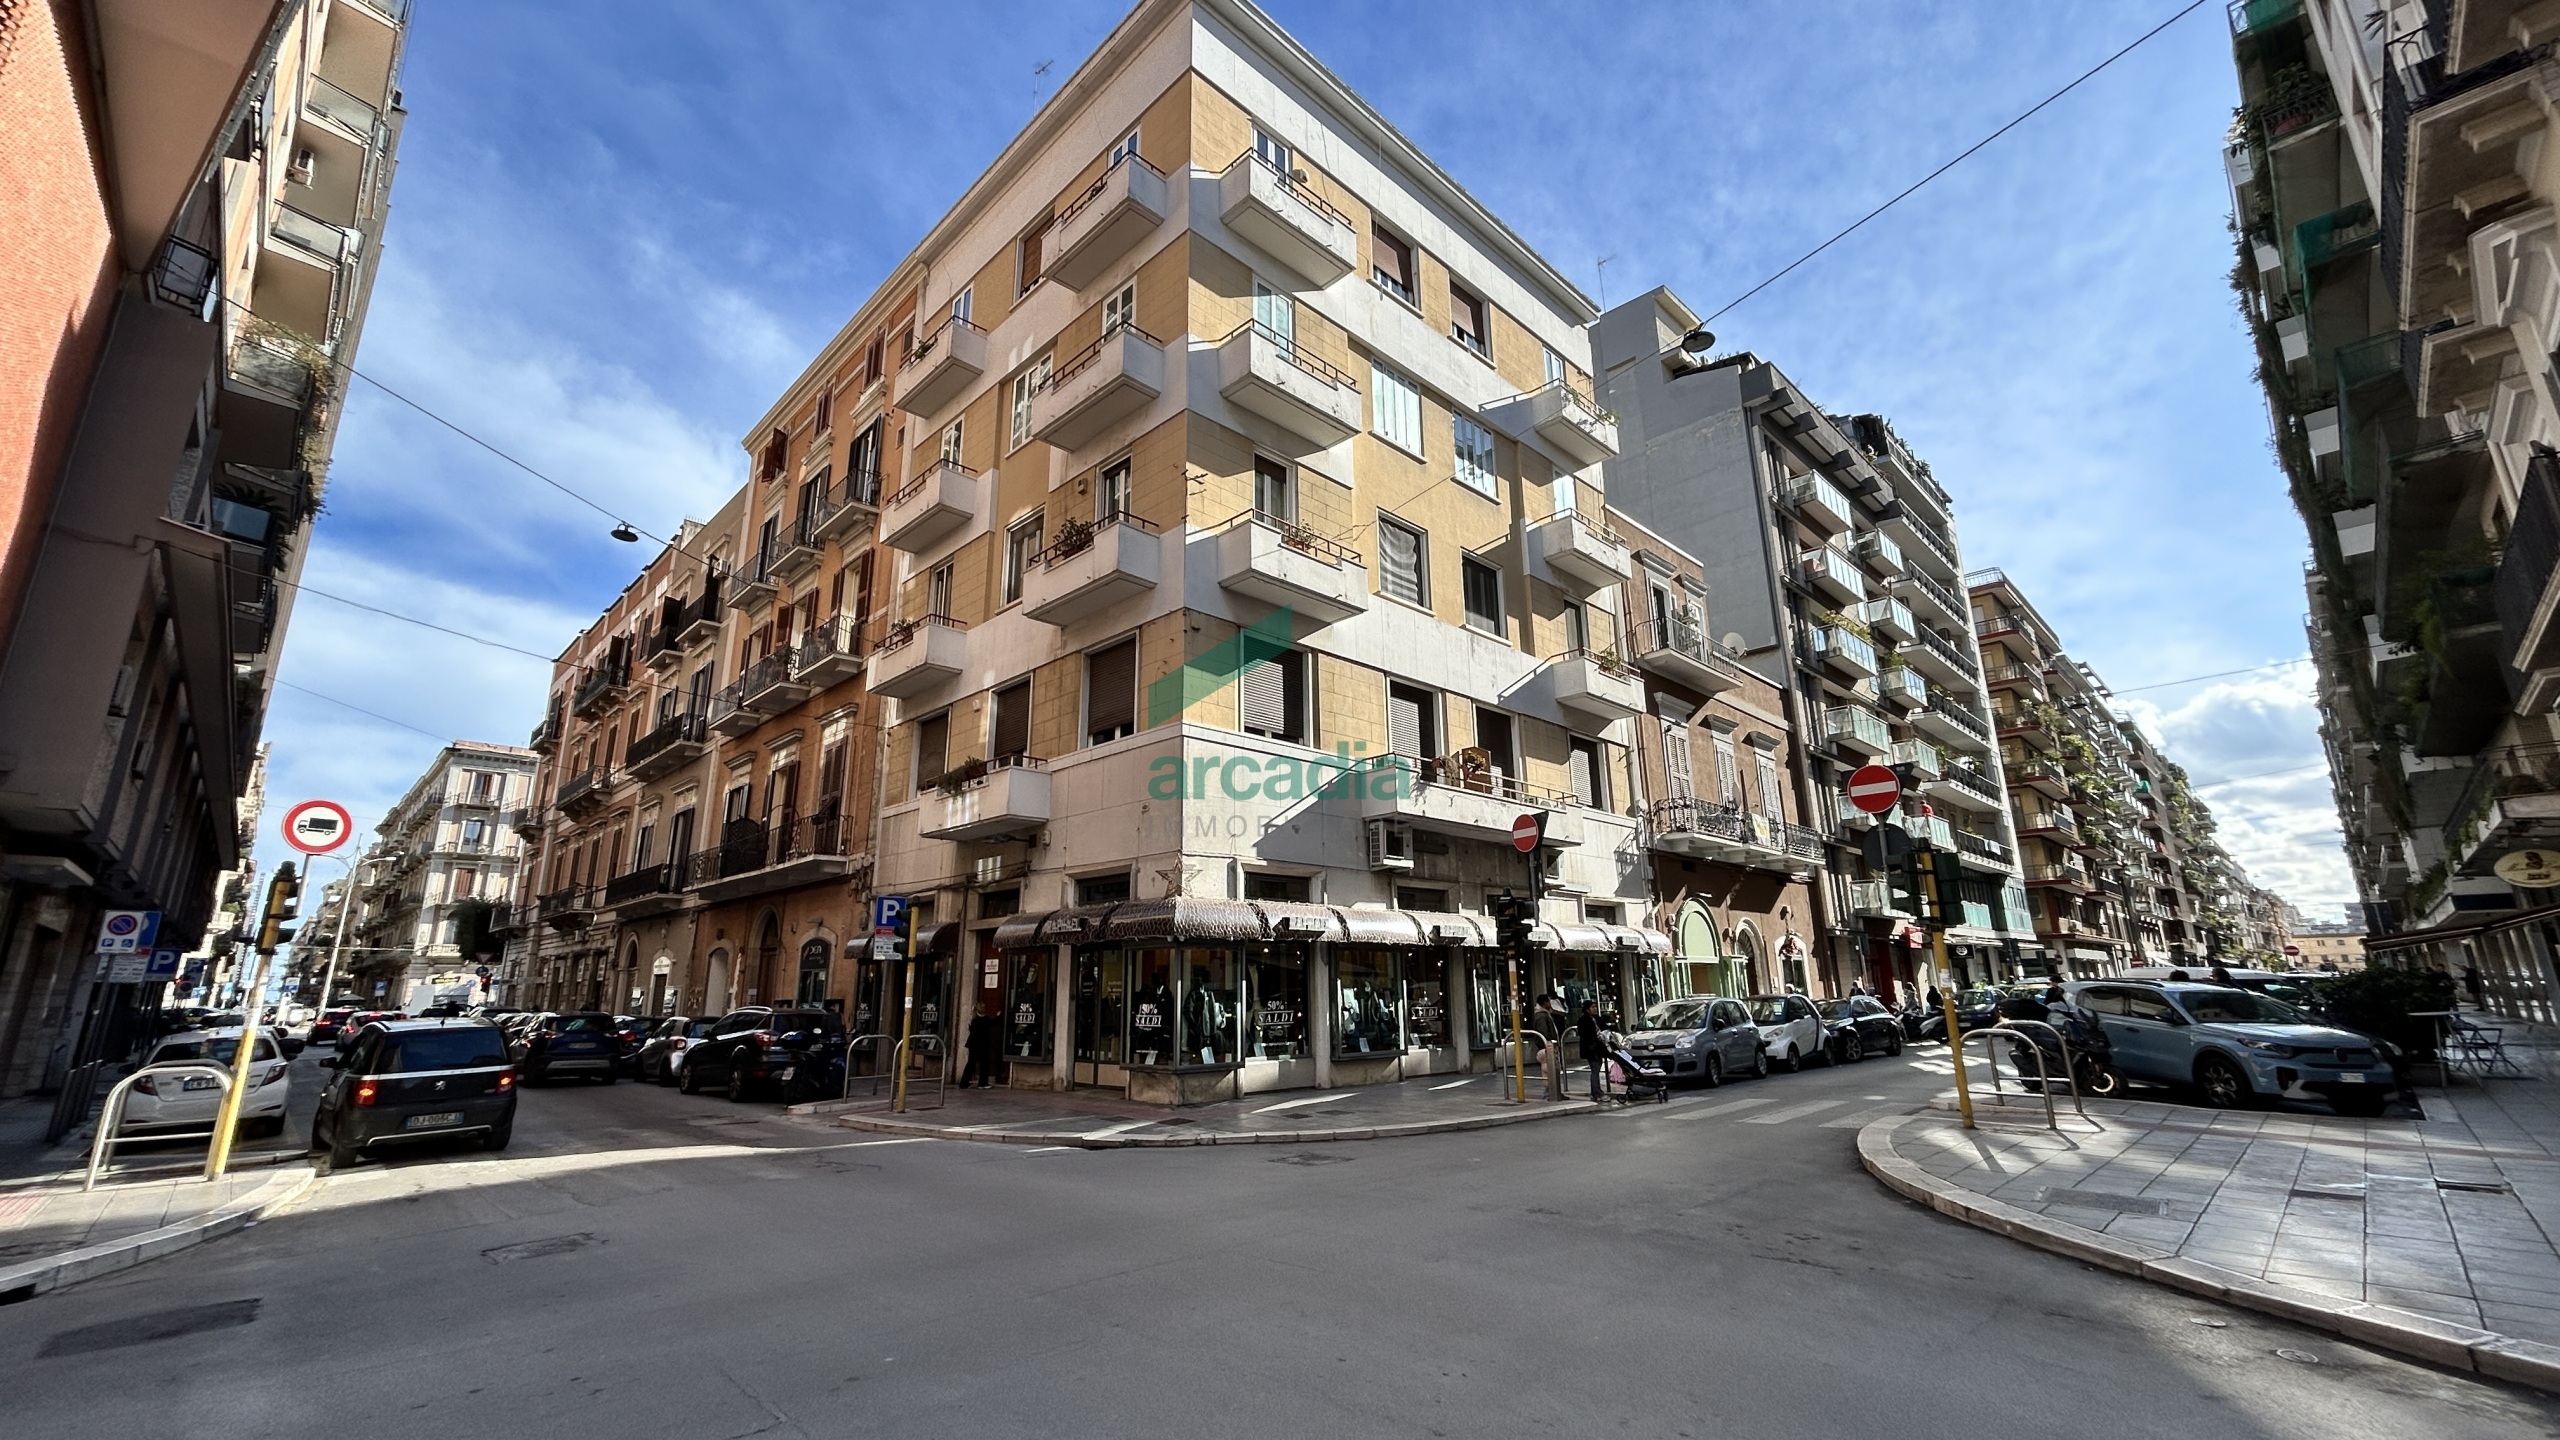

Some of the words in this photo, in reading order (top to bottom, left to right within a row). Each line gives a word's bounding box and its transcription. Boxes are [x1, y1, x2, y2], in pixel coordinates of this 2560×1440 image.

[881, 899, 900, 925] P
[151, 951, 175, 971] P
[1267, 1000, 1285, 1010] 50%
[1014, 1014, 1035, 1022] SALDI
[1135, 1016, 1161, 1026] SALDI
[1259, 1012, 1294, 1023] SALDI
